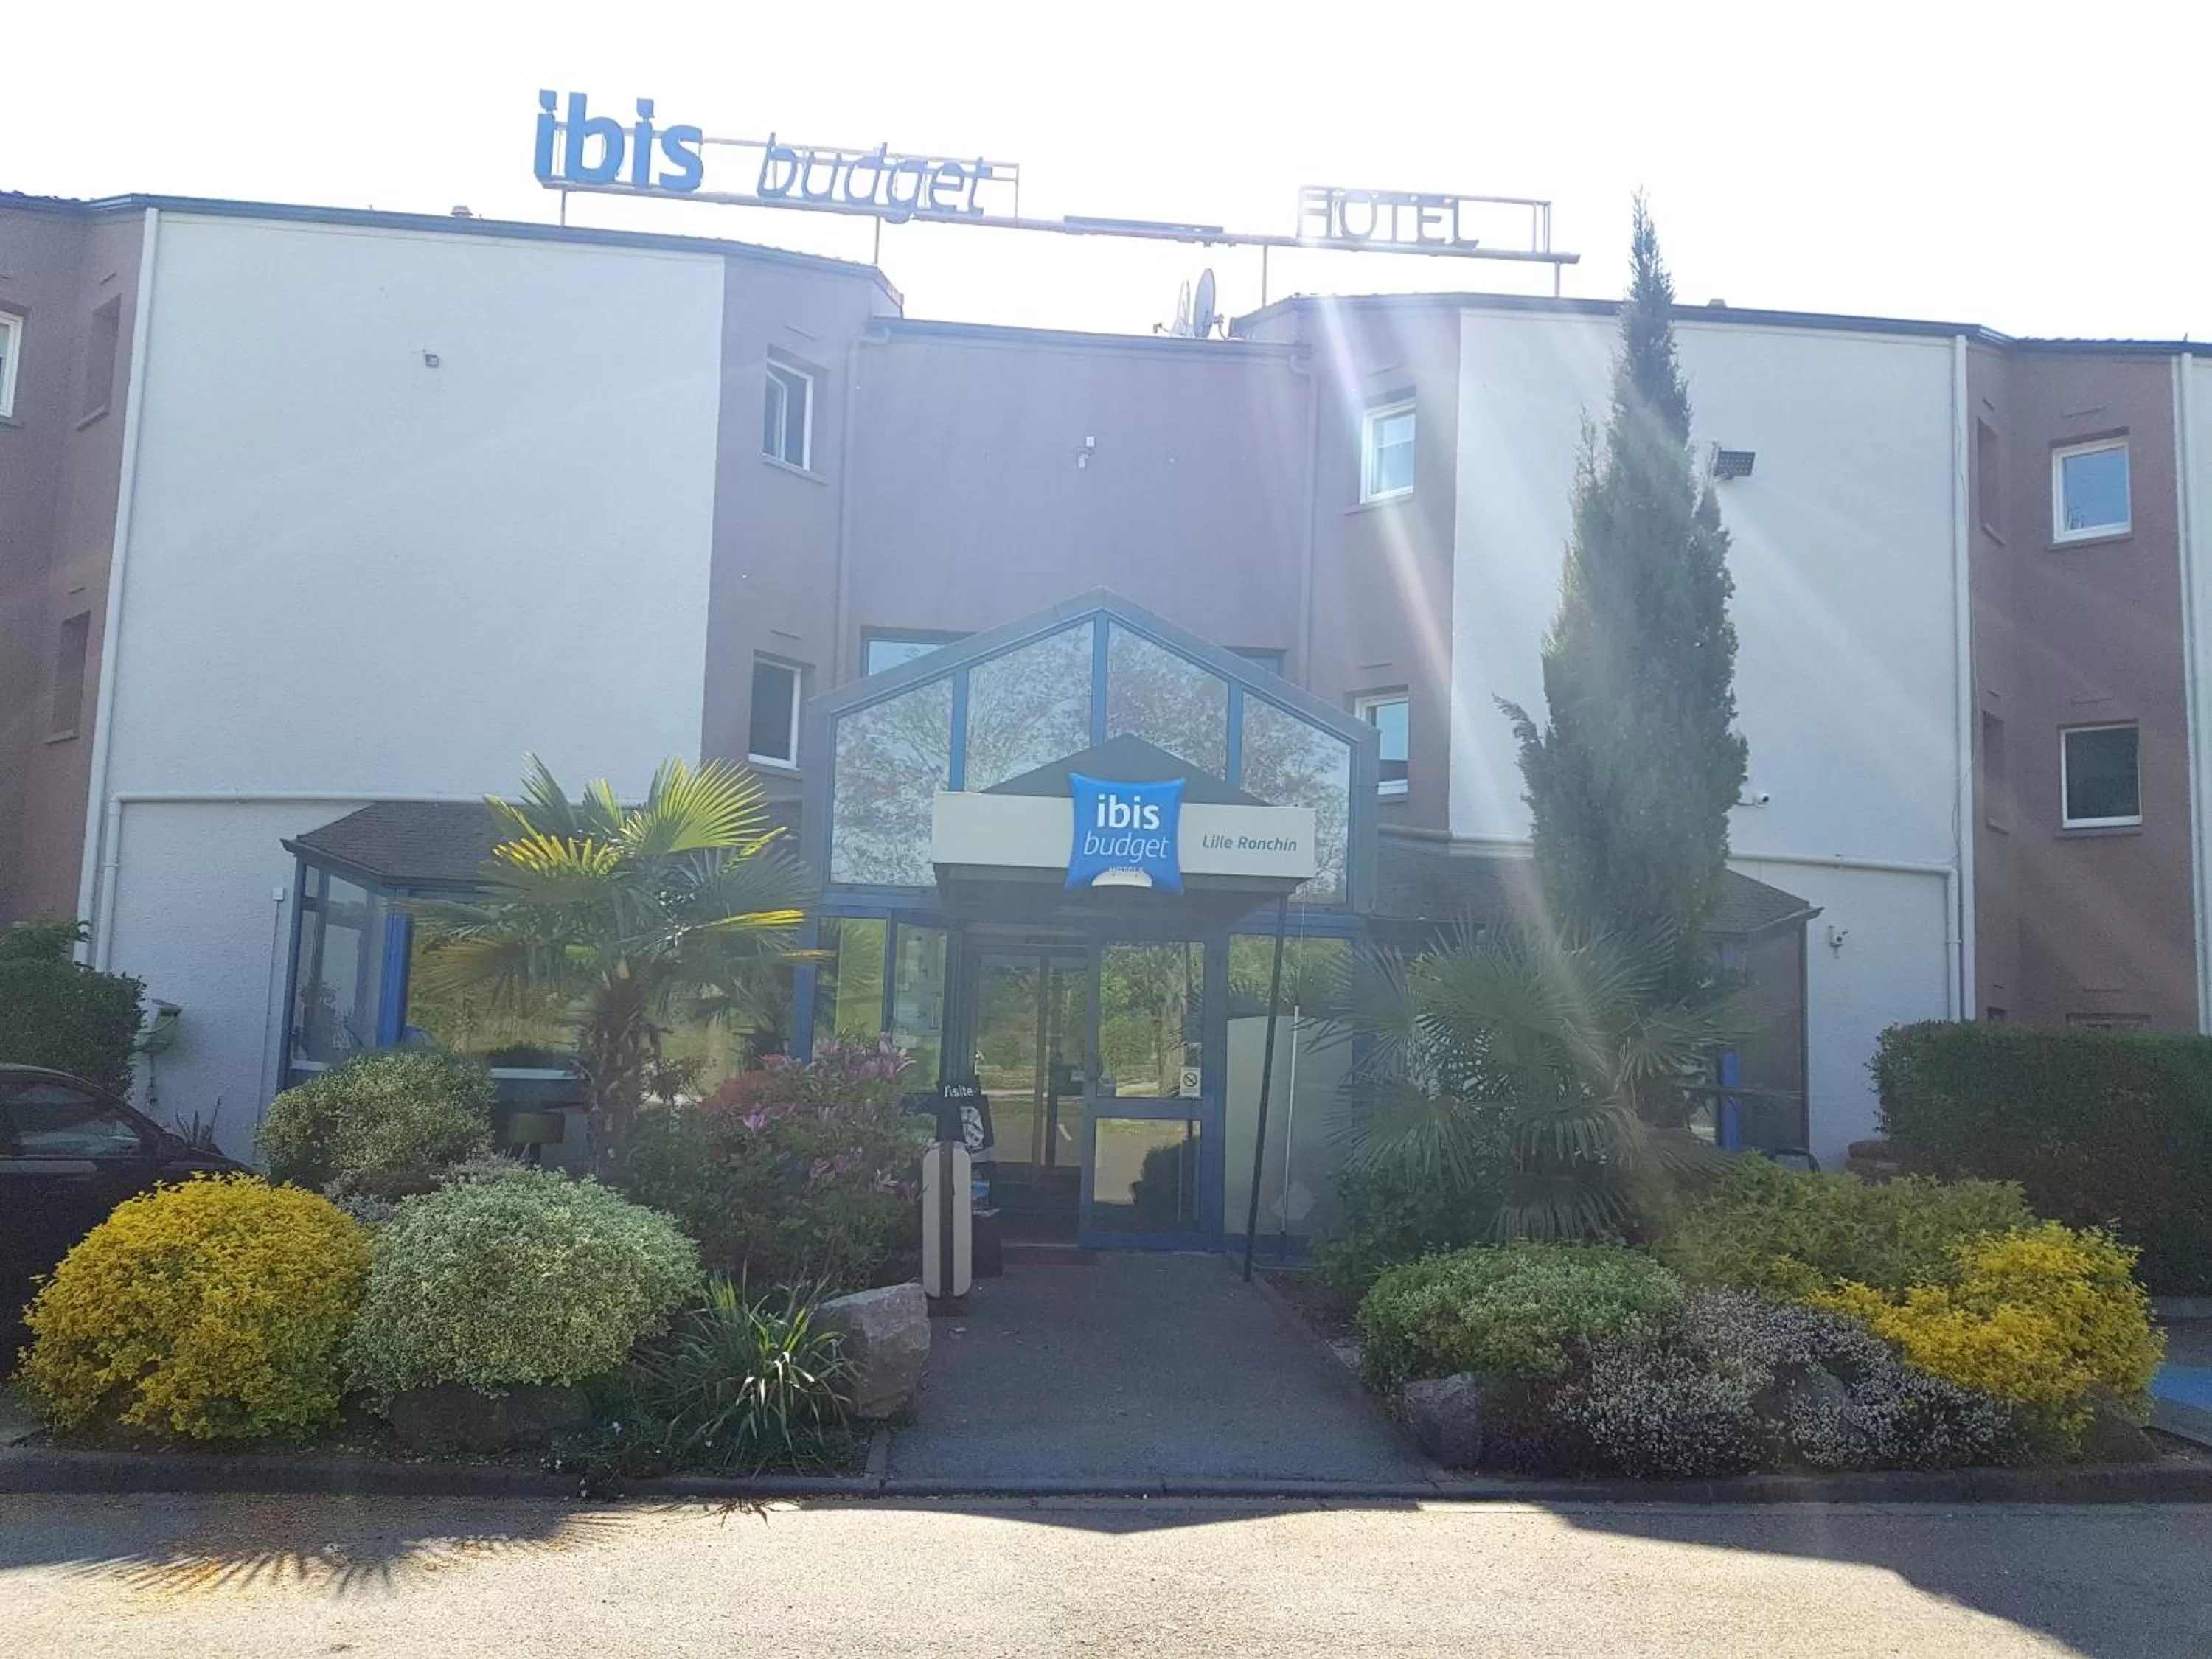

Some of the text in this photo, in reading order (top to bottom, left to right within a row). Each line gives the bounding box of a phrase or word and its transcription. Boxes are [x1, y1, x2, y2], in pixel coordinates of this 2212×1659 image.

[534, 89, 992, 224] ibis budget
[1298, 186, 1479, 249] HOTEL
[1096, 794, 1160, 830] ibis
[1083, 830, 1169, 863] budget
[1203, 834, 1298, 852] Lille Ronchin
